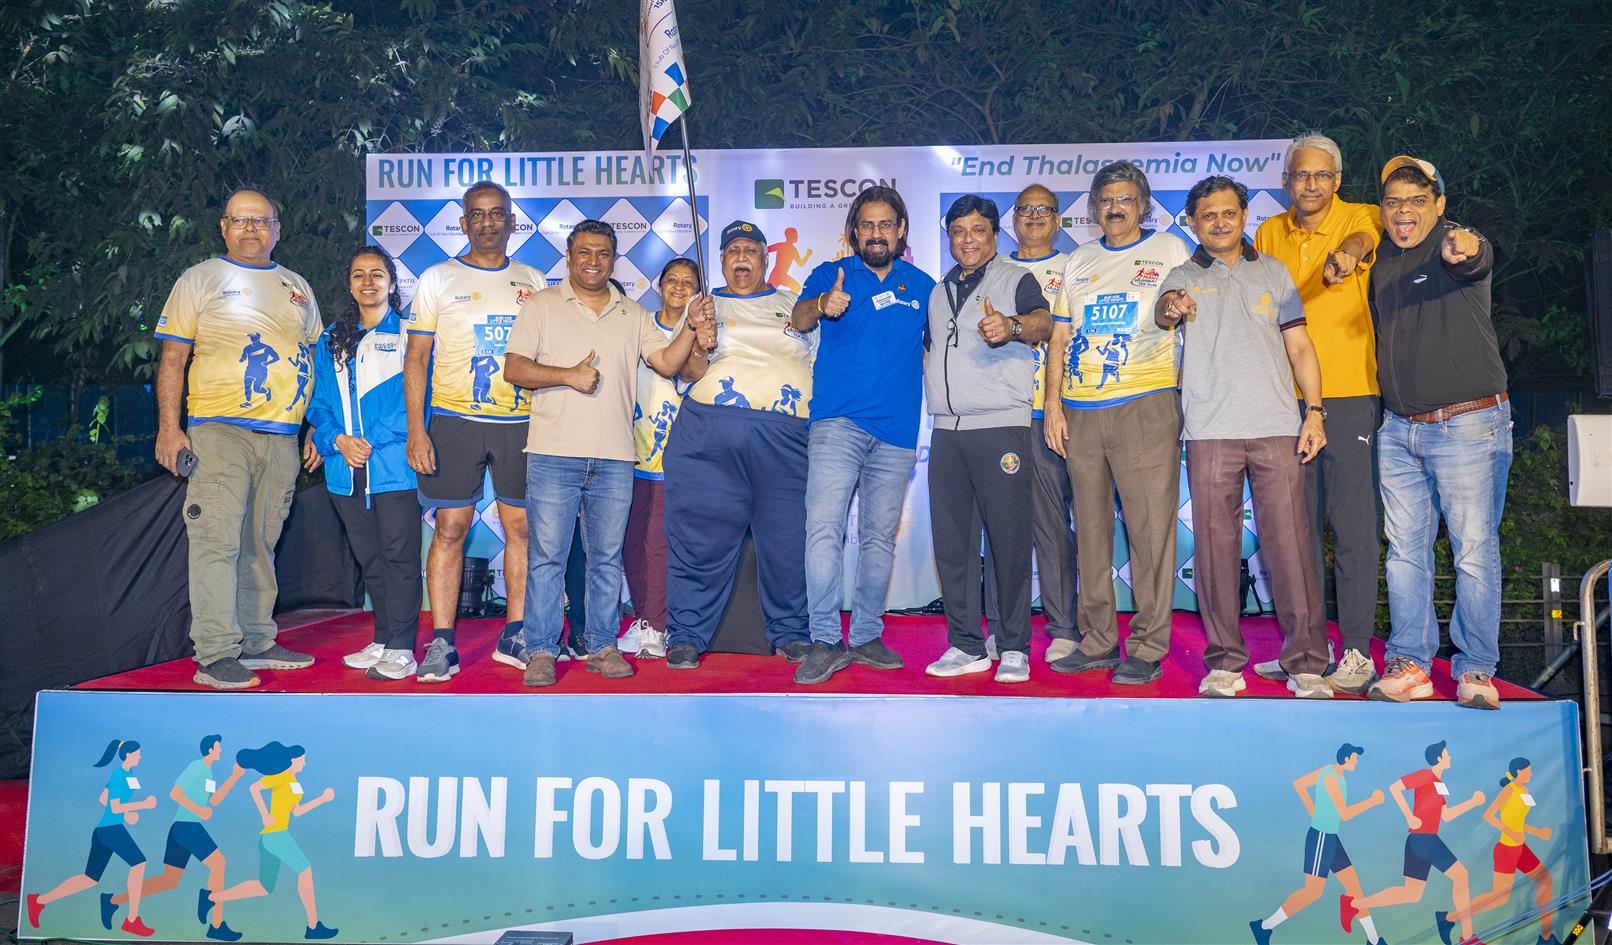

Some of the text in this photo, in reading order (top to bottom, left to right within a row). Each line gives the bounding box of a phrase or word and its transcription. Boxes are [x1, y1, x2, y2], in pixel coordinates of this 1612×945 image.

[378, 154, 698, 189] RUN FOR LITTLE HEARTS
[951, 155, 1015, 176] "End
[1206, 152, 1281, 173] Now"
[384, 225, 420, 233] TESCON
[515, 223, 533, 231] CON
[611, 222, 647, 230] TESCON
[1090, 304, 1128, 320] 5107
[484, 326, 512, 341] 507
[354, 776, 1241, 869] RUN FOR LITTLE HEARTS
